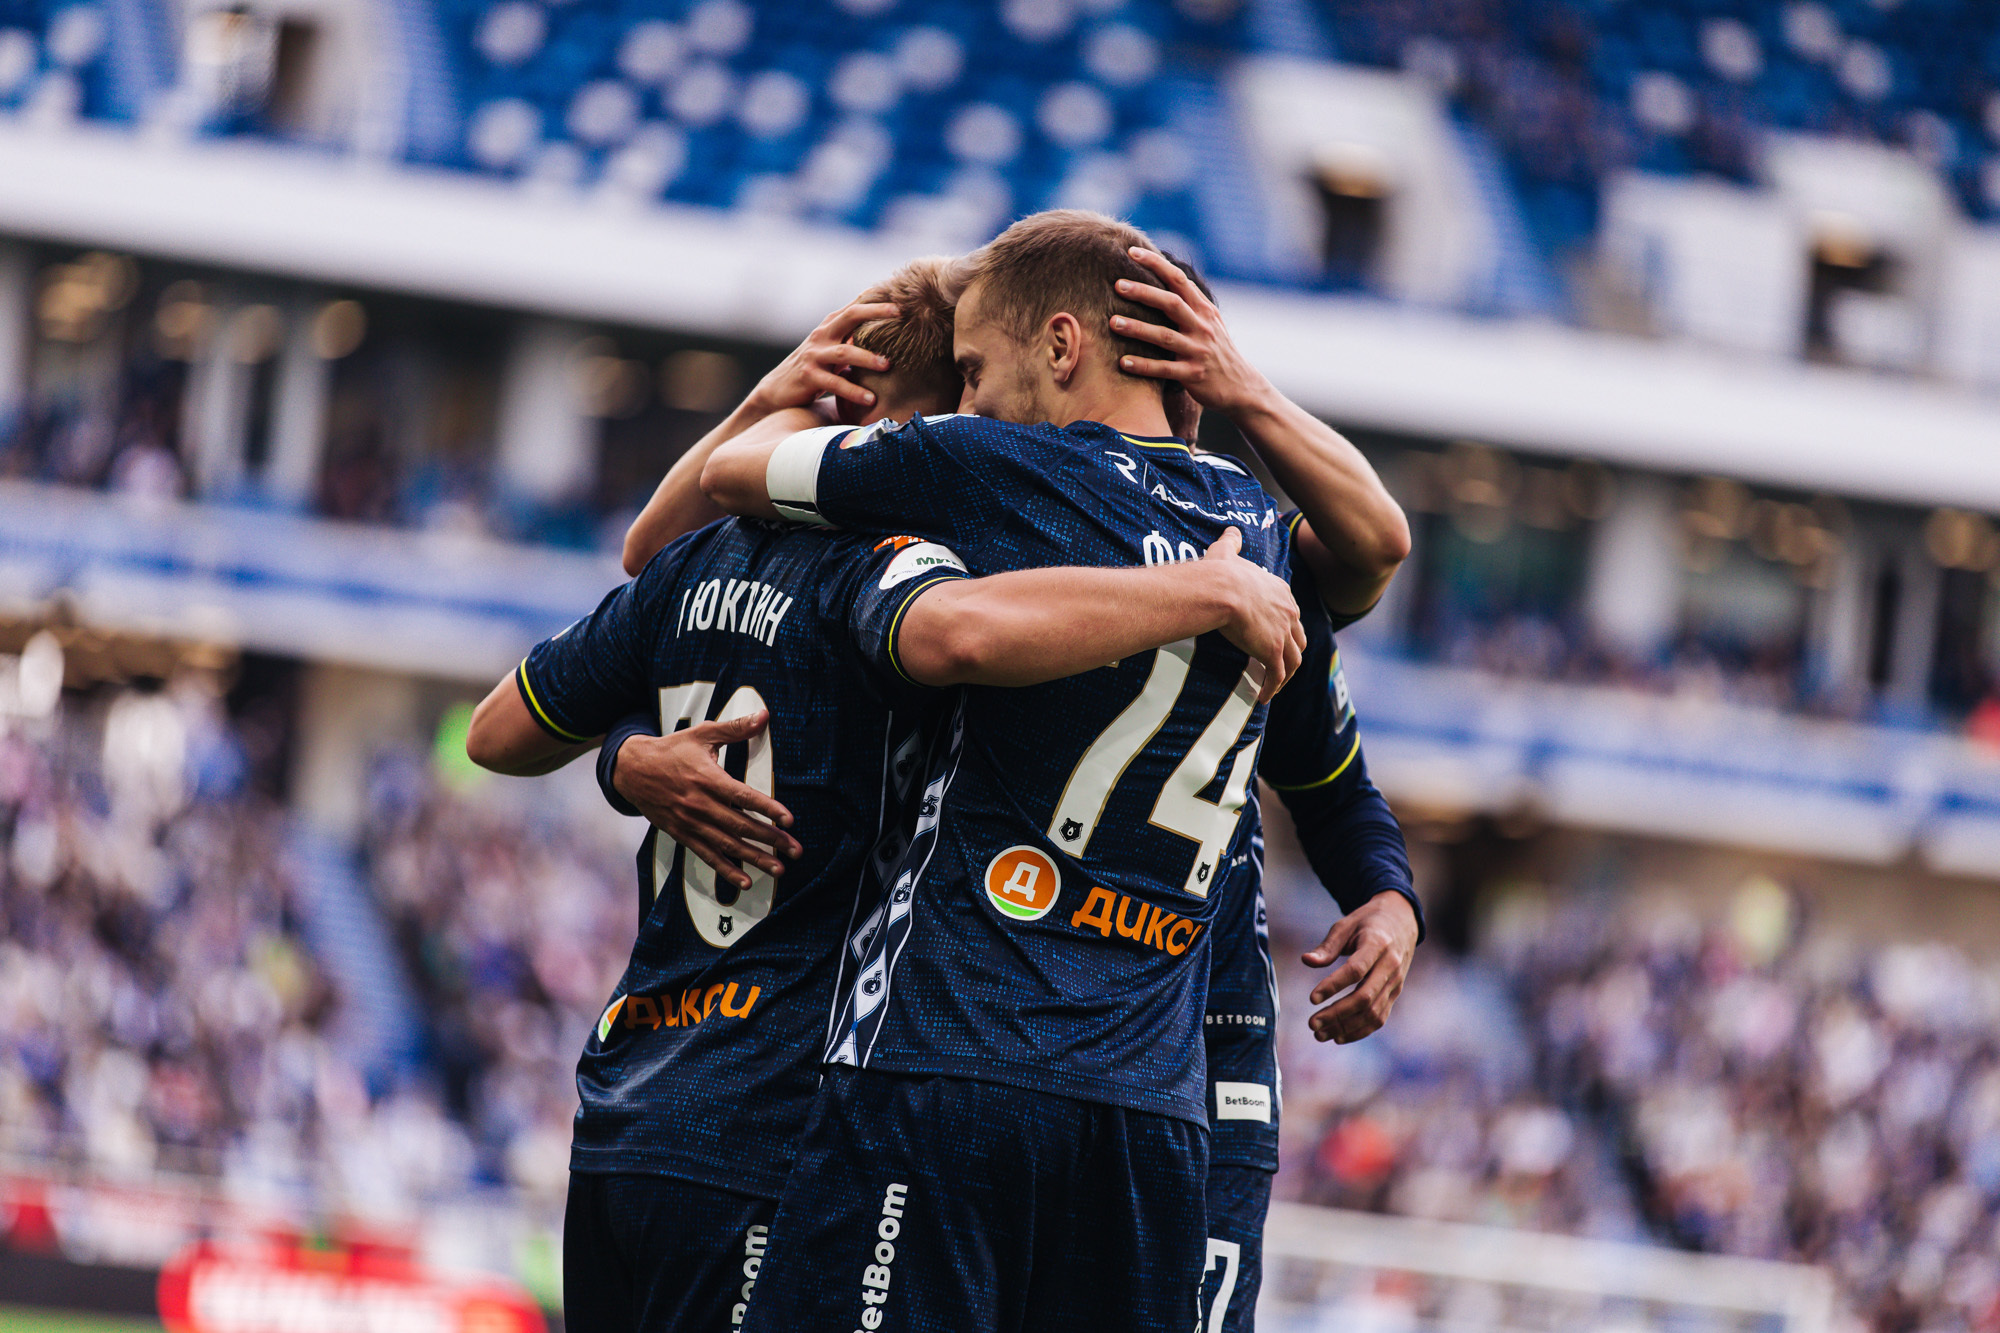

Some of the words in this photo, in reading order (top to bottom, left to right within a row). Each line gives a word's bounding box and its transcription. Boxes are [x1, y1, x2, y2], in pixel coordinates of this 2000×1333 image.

[1071, 886, 1206, 957] ДИКС
[1205, 1014, 1267, 1027] BETBOOM
[1225, 1096, 1266, 1108] BetBoom
[853, 1182, 909, 1333] etBoom
